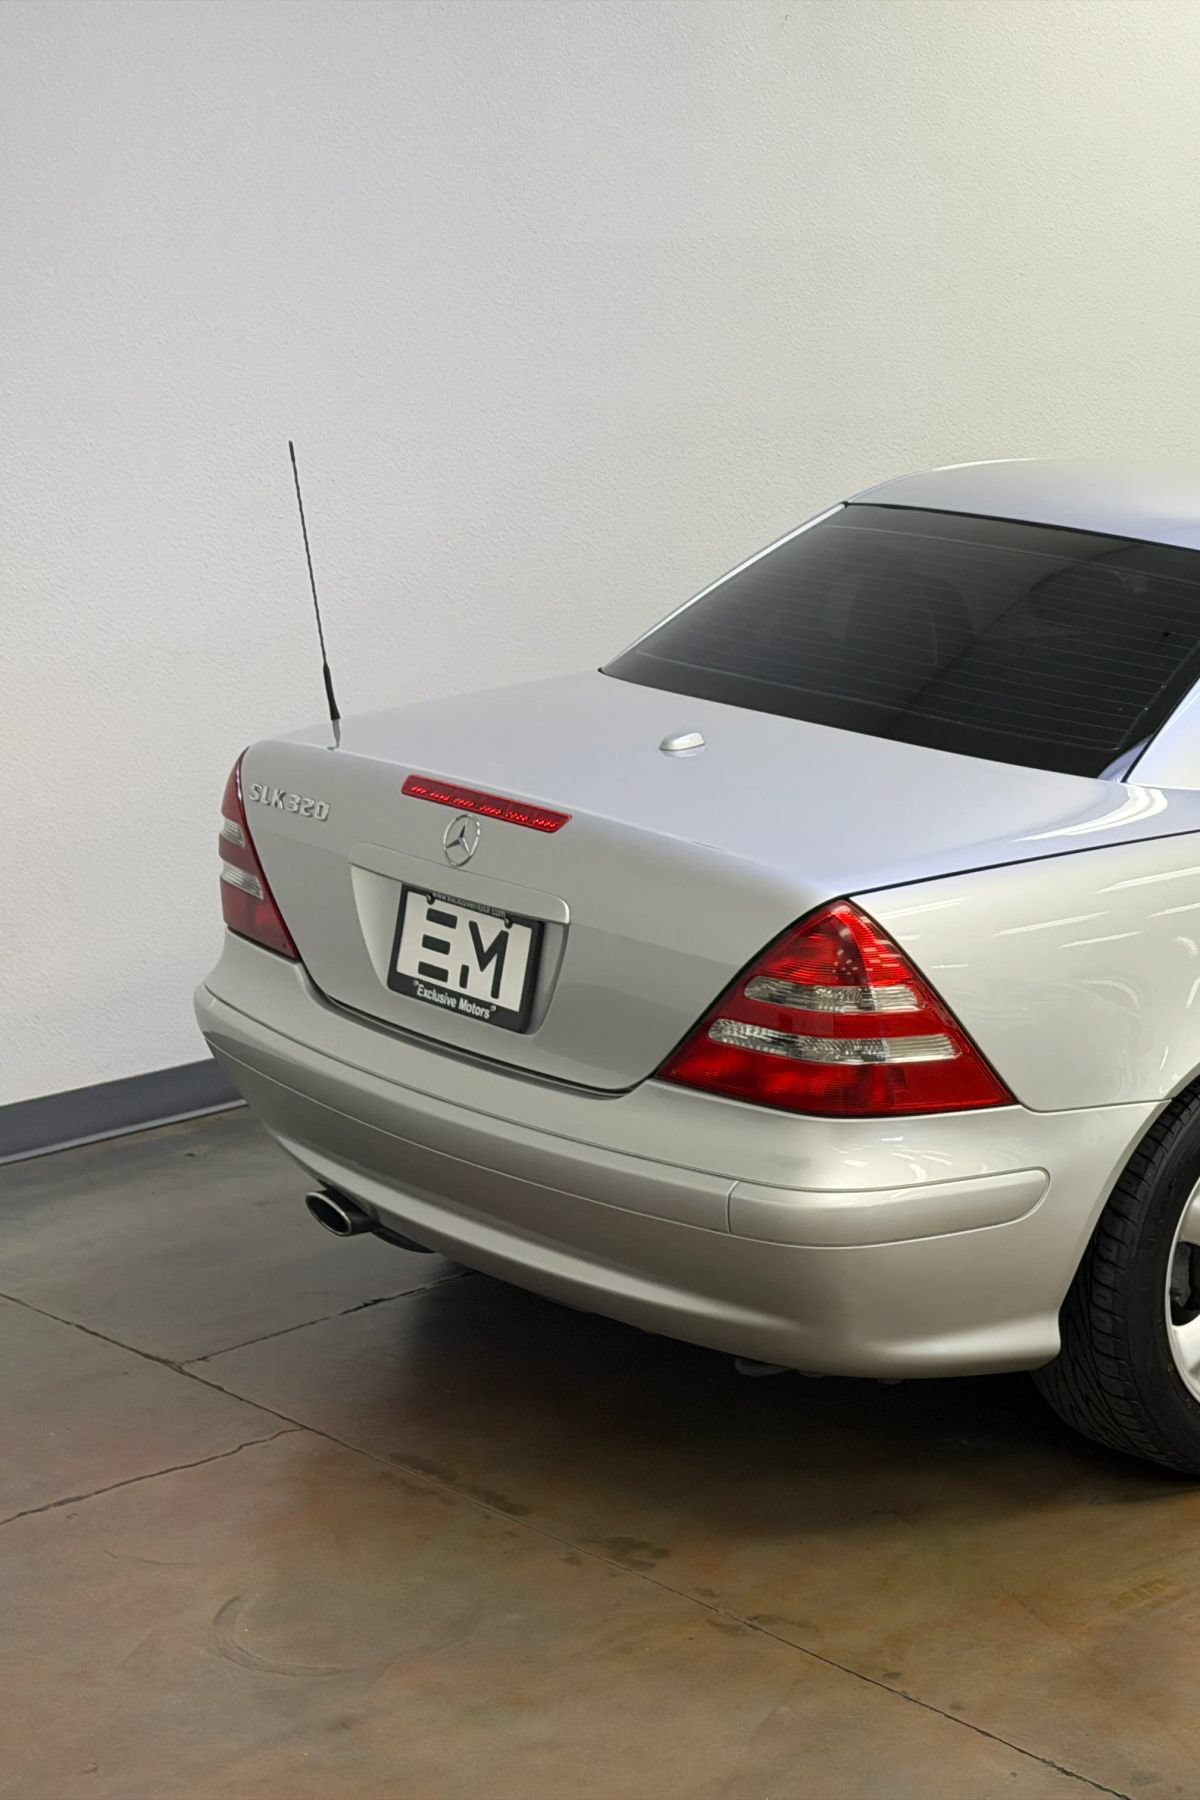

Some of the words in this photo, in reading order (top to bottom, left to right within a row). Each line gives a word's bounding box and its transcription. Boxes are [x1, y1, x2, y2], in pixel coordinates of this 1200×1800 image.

[249, 783, 331, 822] SLK320
[416, 984, 457, 1008] Exclusive
[458, 998, 490, 1019] Motors
